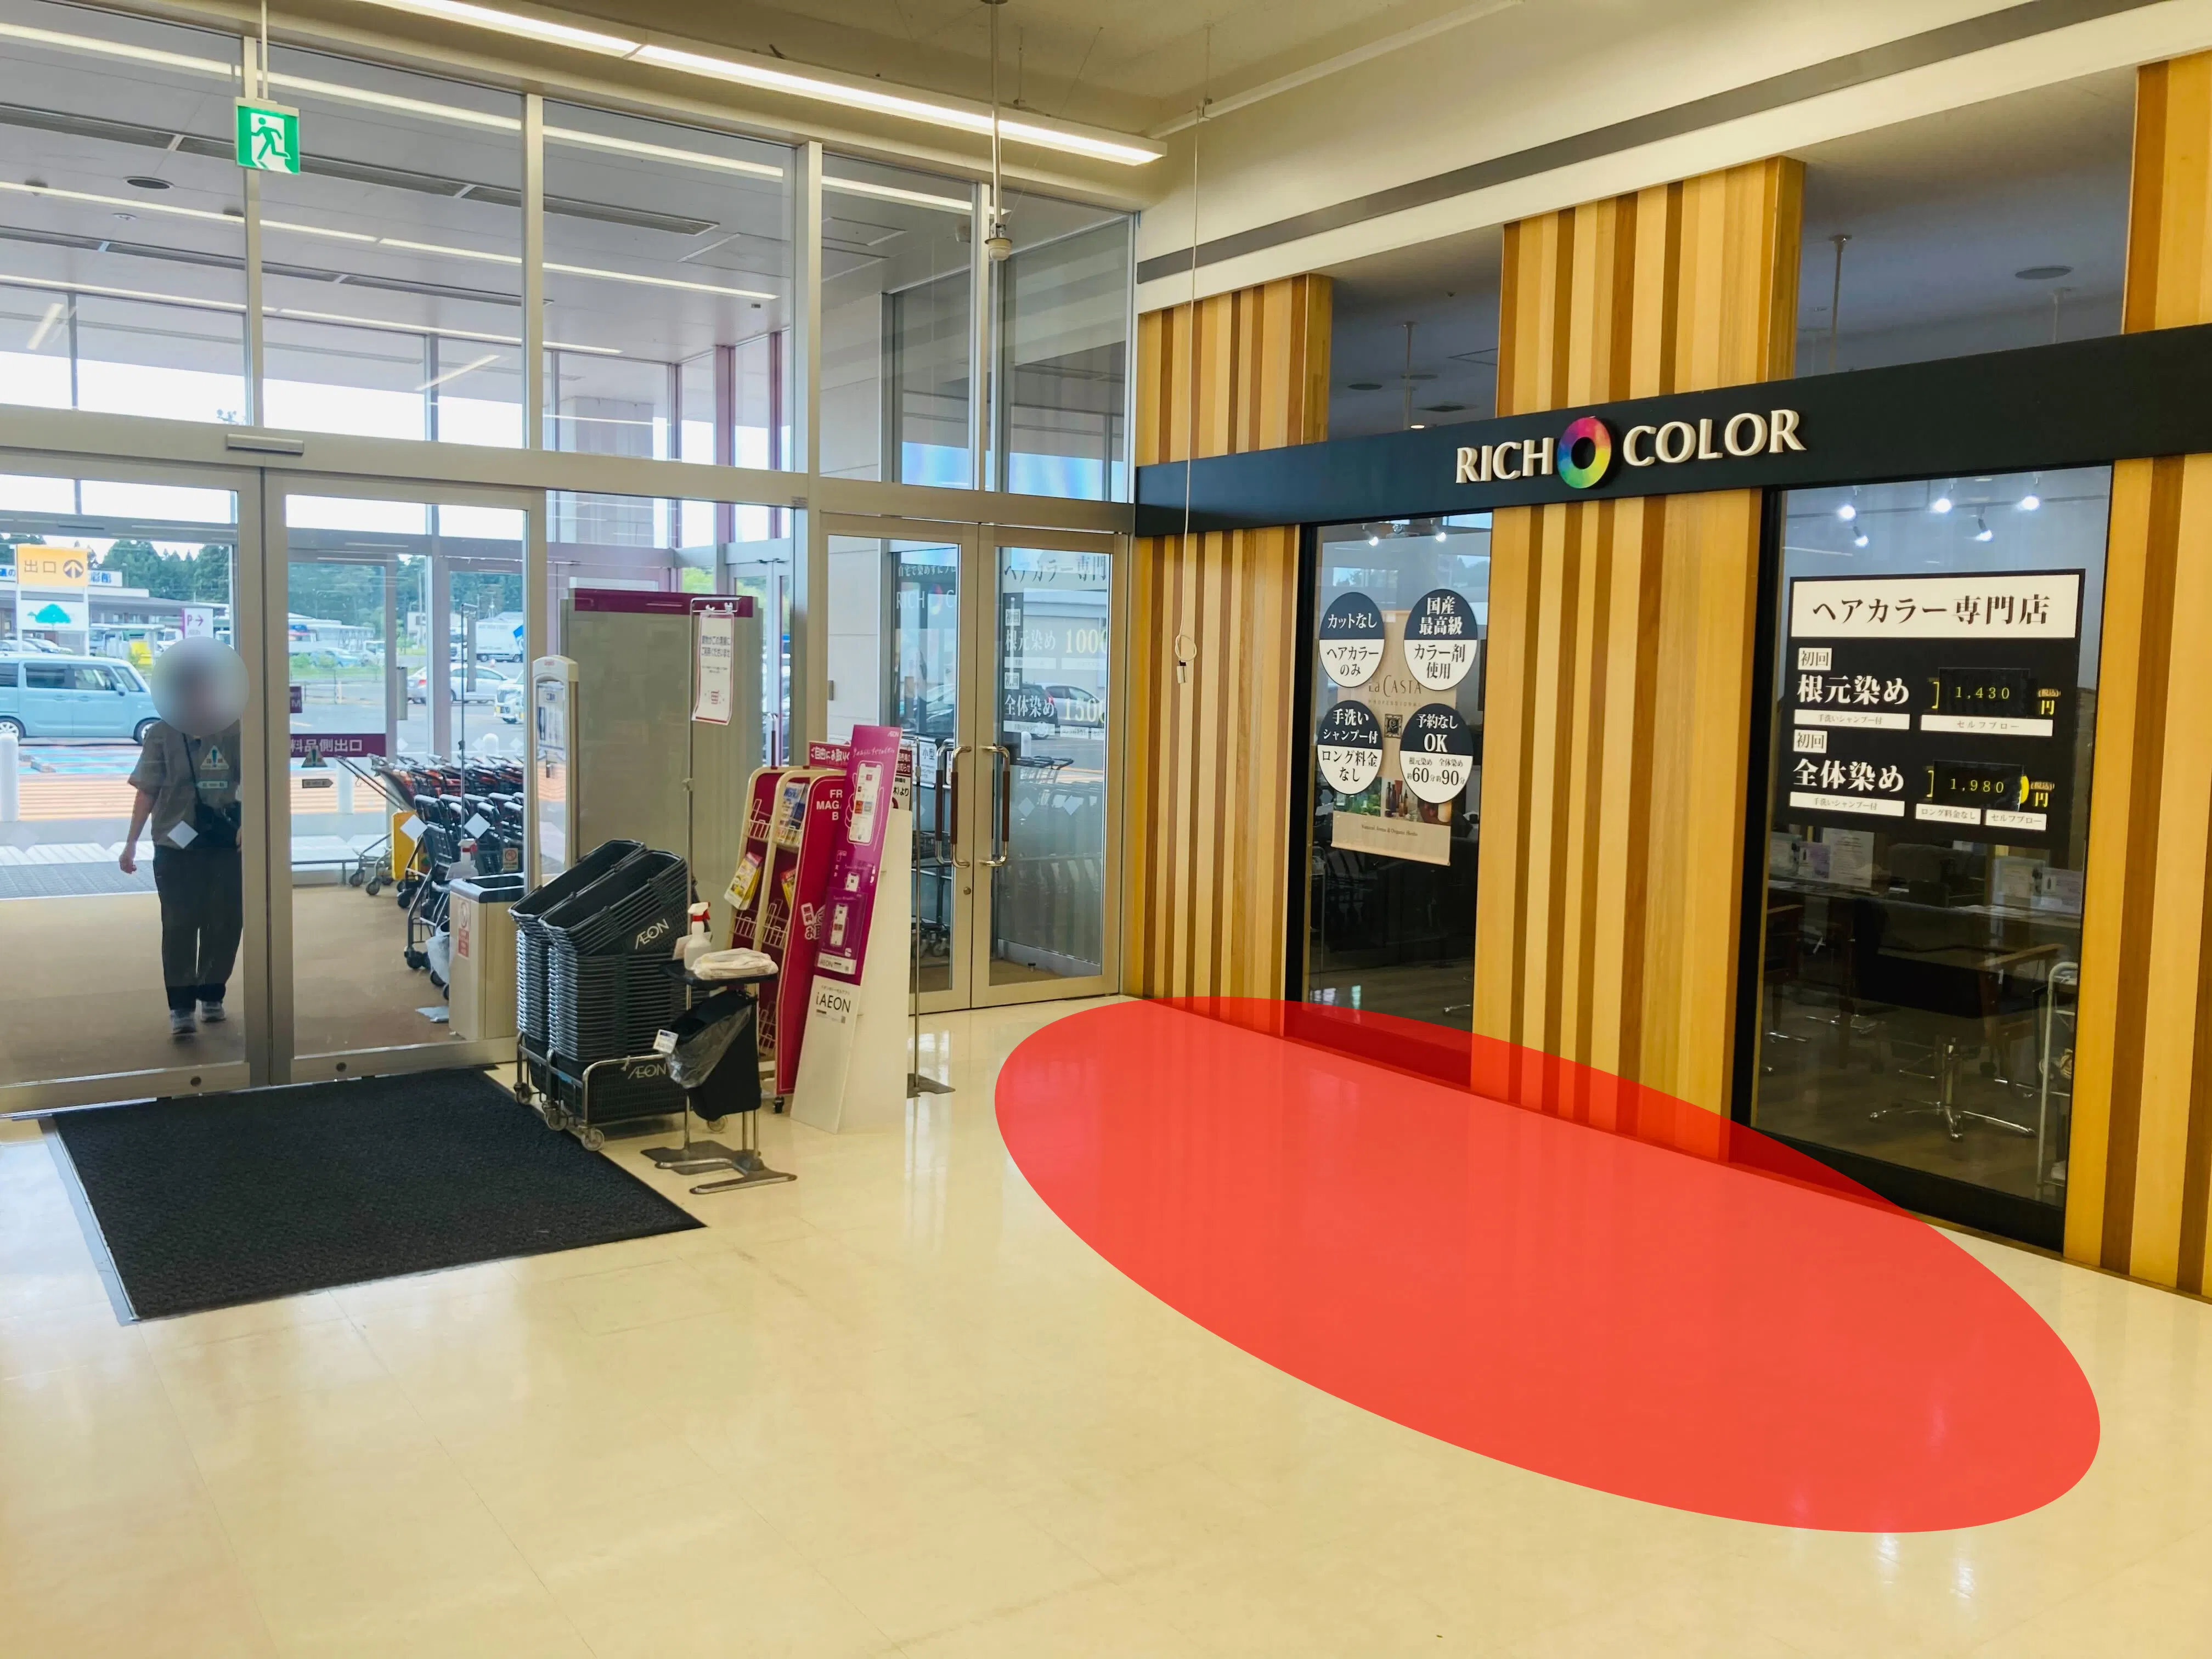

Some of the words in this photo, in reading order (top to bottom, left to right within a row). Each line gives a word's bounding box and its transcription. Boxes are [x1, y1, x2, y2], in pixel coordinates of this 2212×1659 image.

[1455, 437, 1553, 484] RICH
[1623, 409, 1807, 467] COLOR
[24, 559, 57, 573] 出口
[1426, 595, 1455, 615] 国産
[1812, 594, 2051, 625] ヘアカラー専門店
[1328, 613, 1378, 629] カットなし
[1419, 616, 1463, 635] 最高級
[1327, 646, 1379, 661] ヘアカラー
[1414, 644, 1466, 663] カラー剤
[1801, 650, 1829, 667] 初回
[1340, 663, 1361, 676] のみ
[1426, 662, 1451, 680] 使用
[1797, 674, 1910, 705] 根元染め
[1955, 686, 2010, 699] 1,430
[1005, 693, 1055, 718] 全体染め
[1332, 708, 1369, 726] 手洗い
[1416, 714, 1458, 729] 予約なし
[1817, 714, 1883, 725] 手洗いシャンプー付
[1957, 720, 2019, 730] セルフブロー
[1323, 729, 1378, 744] シャンプー付
[1424, 733, 1448, 752] OK
[1797, 732, 1825, 749] 初回
[1322, 750, 1378, 767] ロング料金
[1409, 757, 1432, 766] 根元染め
[1440, 758, 1463, 767] 全体染め
[1339, 766, 1361, 782] なし
[1793, 758, 1905, 792] 全体染め
[1950, 778, 2005, 793] 1,980
[816, 800, 841, 810] MAG
[1814, 798, 1878, 810] 手洗いシャンプー付
[1921, 808, 1976, 820] ロング料金なし
[1991, 815, 2042, 824] セルフブロー
[816, 991, 851, 1013] iAEON
